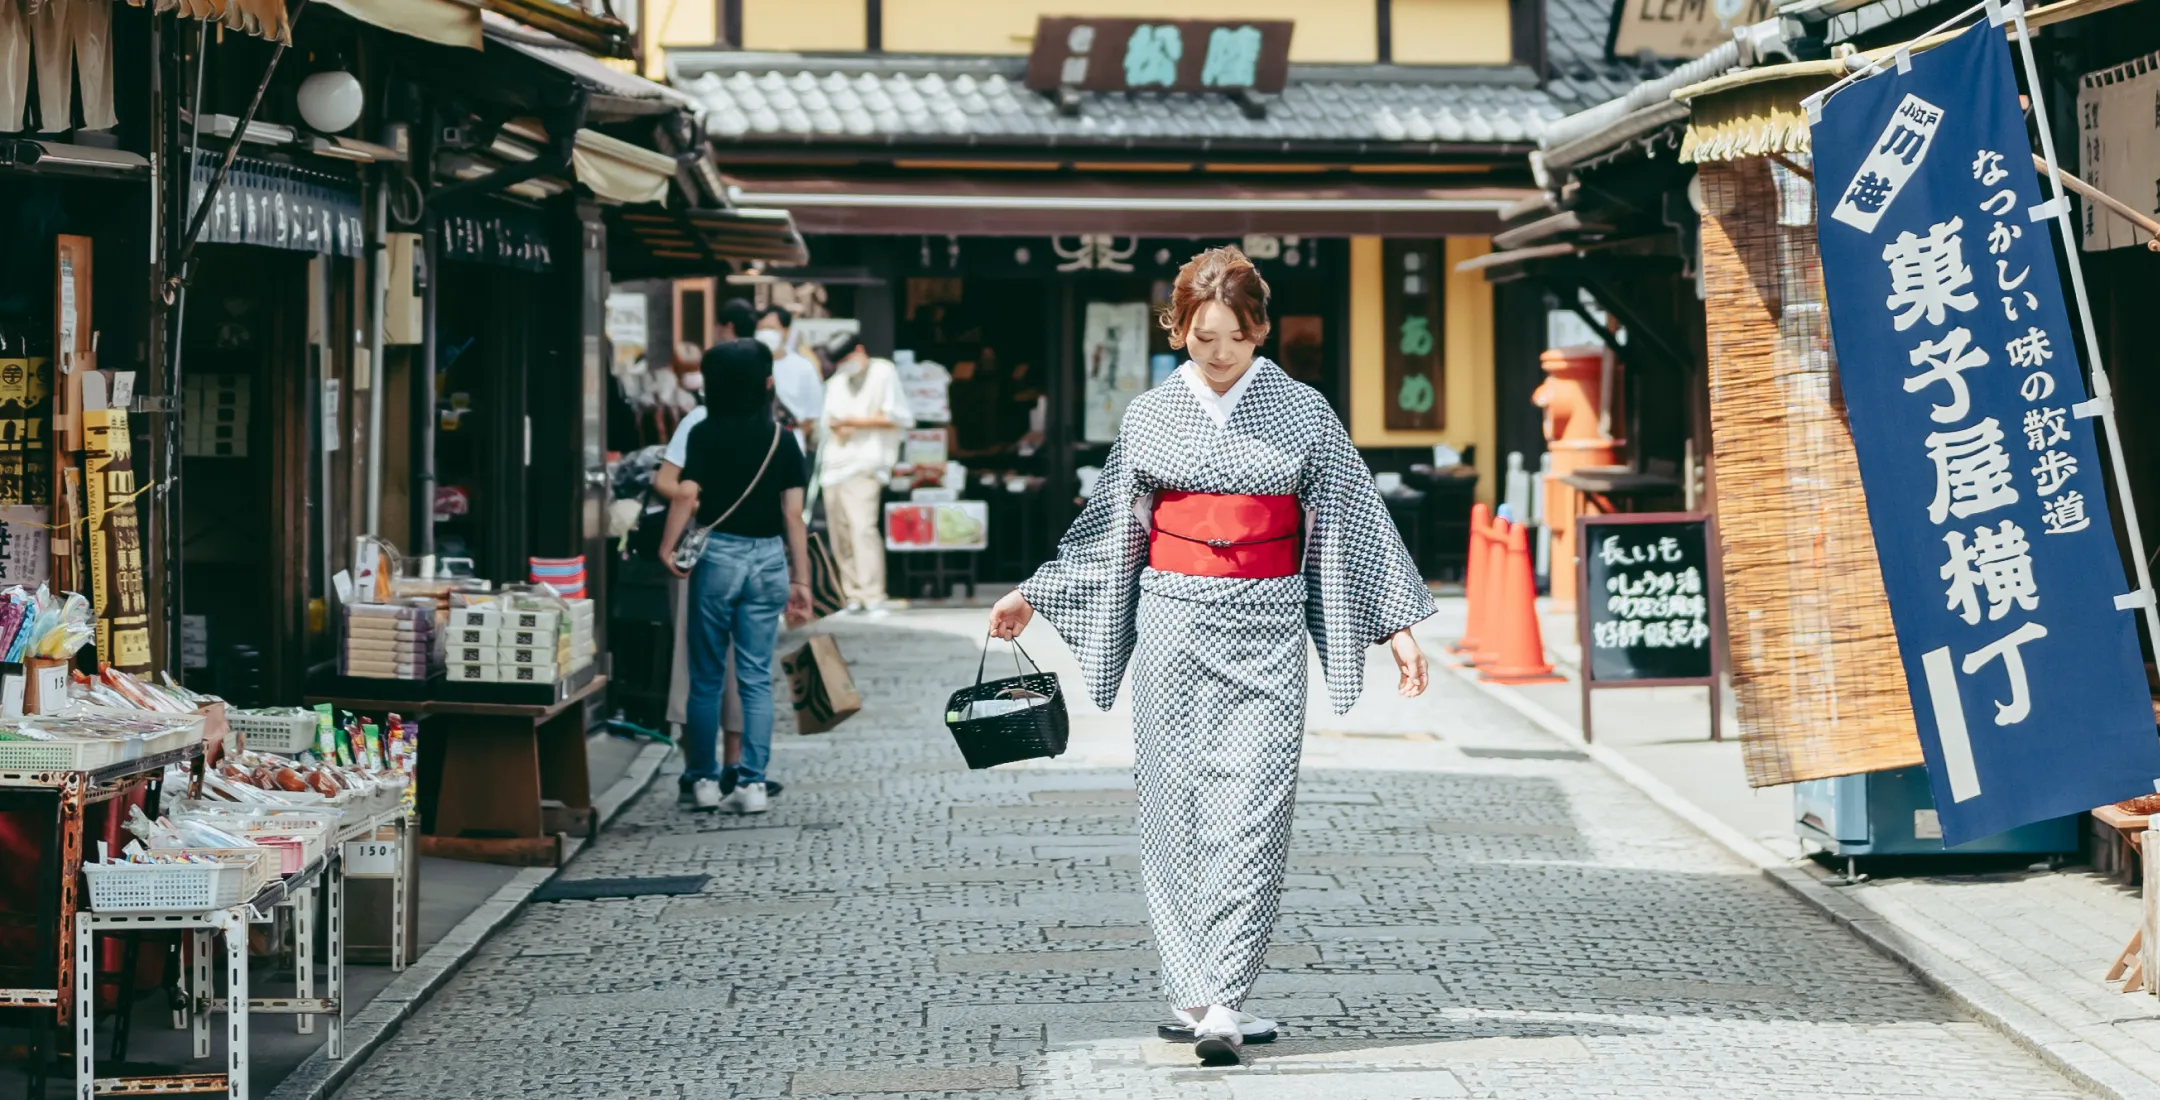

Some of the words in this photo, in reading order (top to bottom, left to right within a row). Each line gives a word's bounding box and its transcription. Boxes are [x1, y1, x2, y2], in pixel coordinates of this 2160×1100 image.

[1900, 101, 1939, 128] 小江戸
[1844, 124, 1926, 214] 川越
[1398, 315, 1435, 413] あめ
[1972, 149, 2091, 535] なつかしい味の散歩道
[1881, 215, 2048, 726] 菓子屋横丁
[1598, 535, 1683, 566] 長いも
[1593, 618, 1710, 650] 好評販売中
